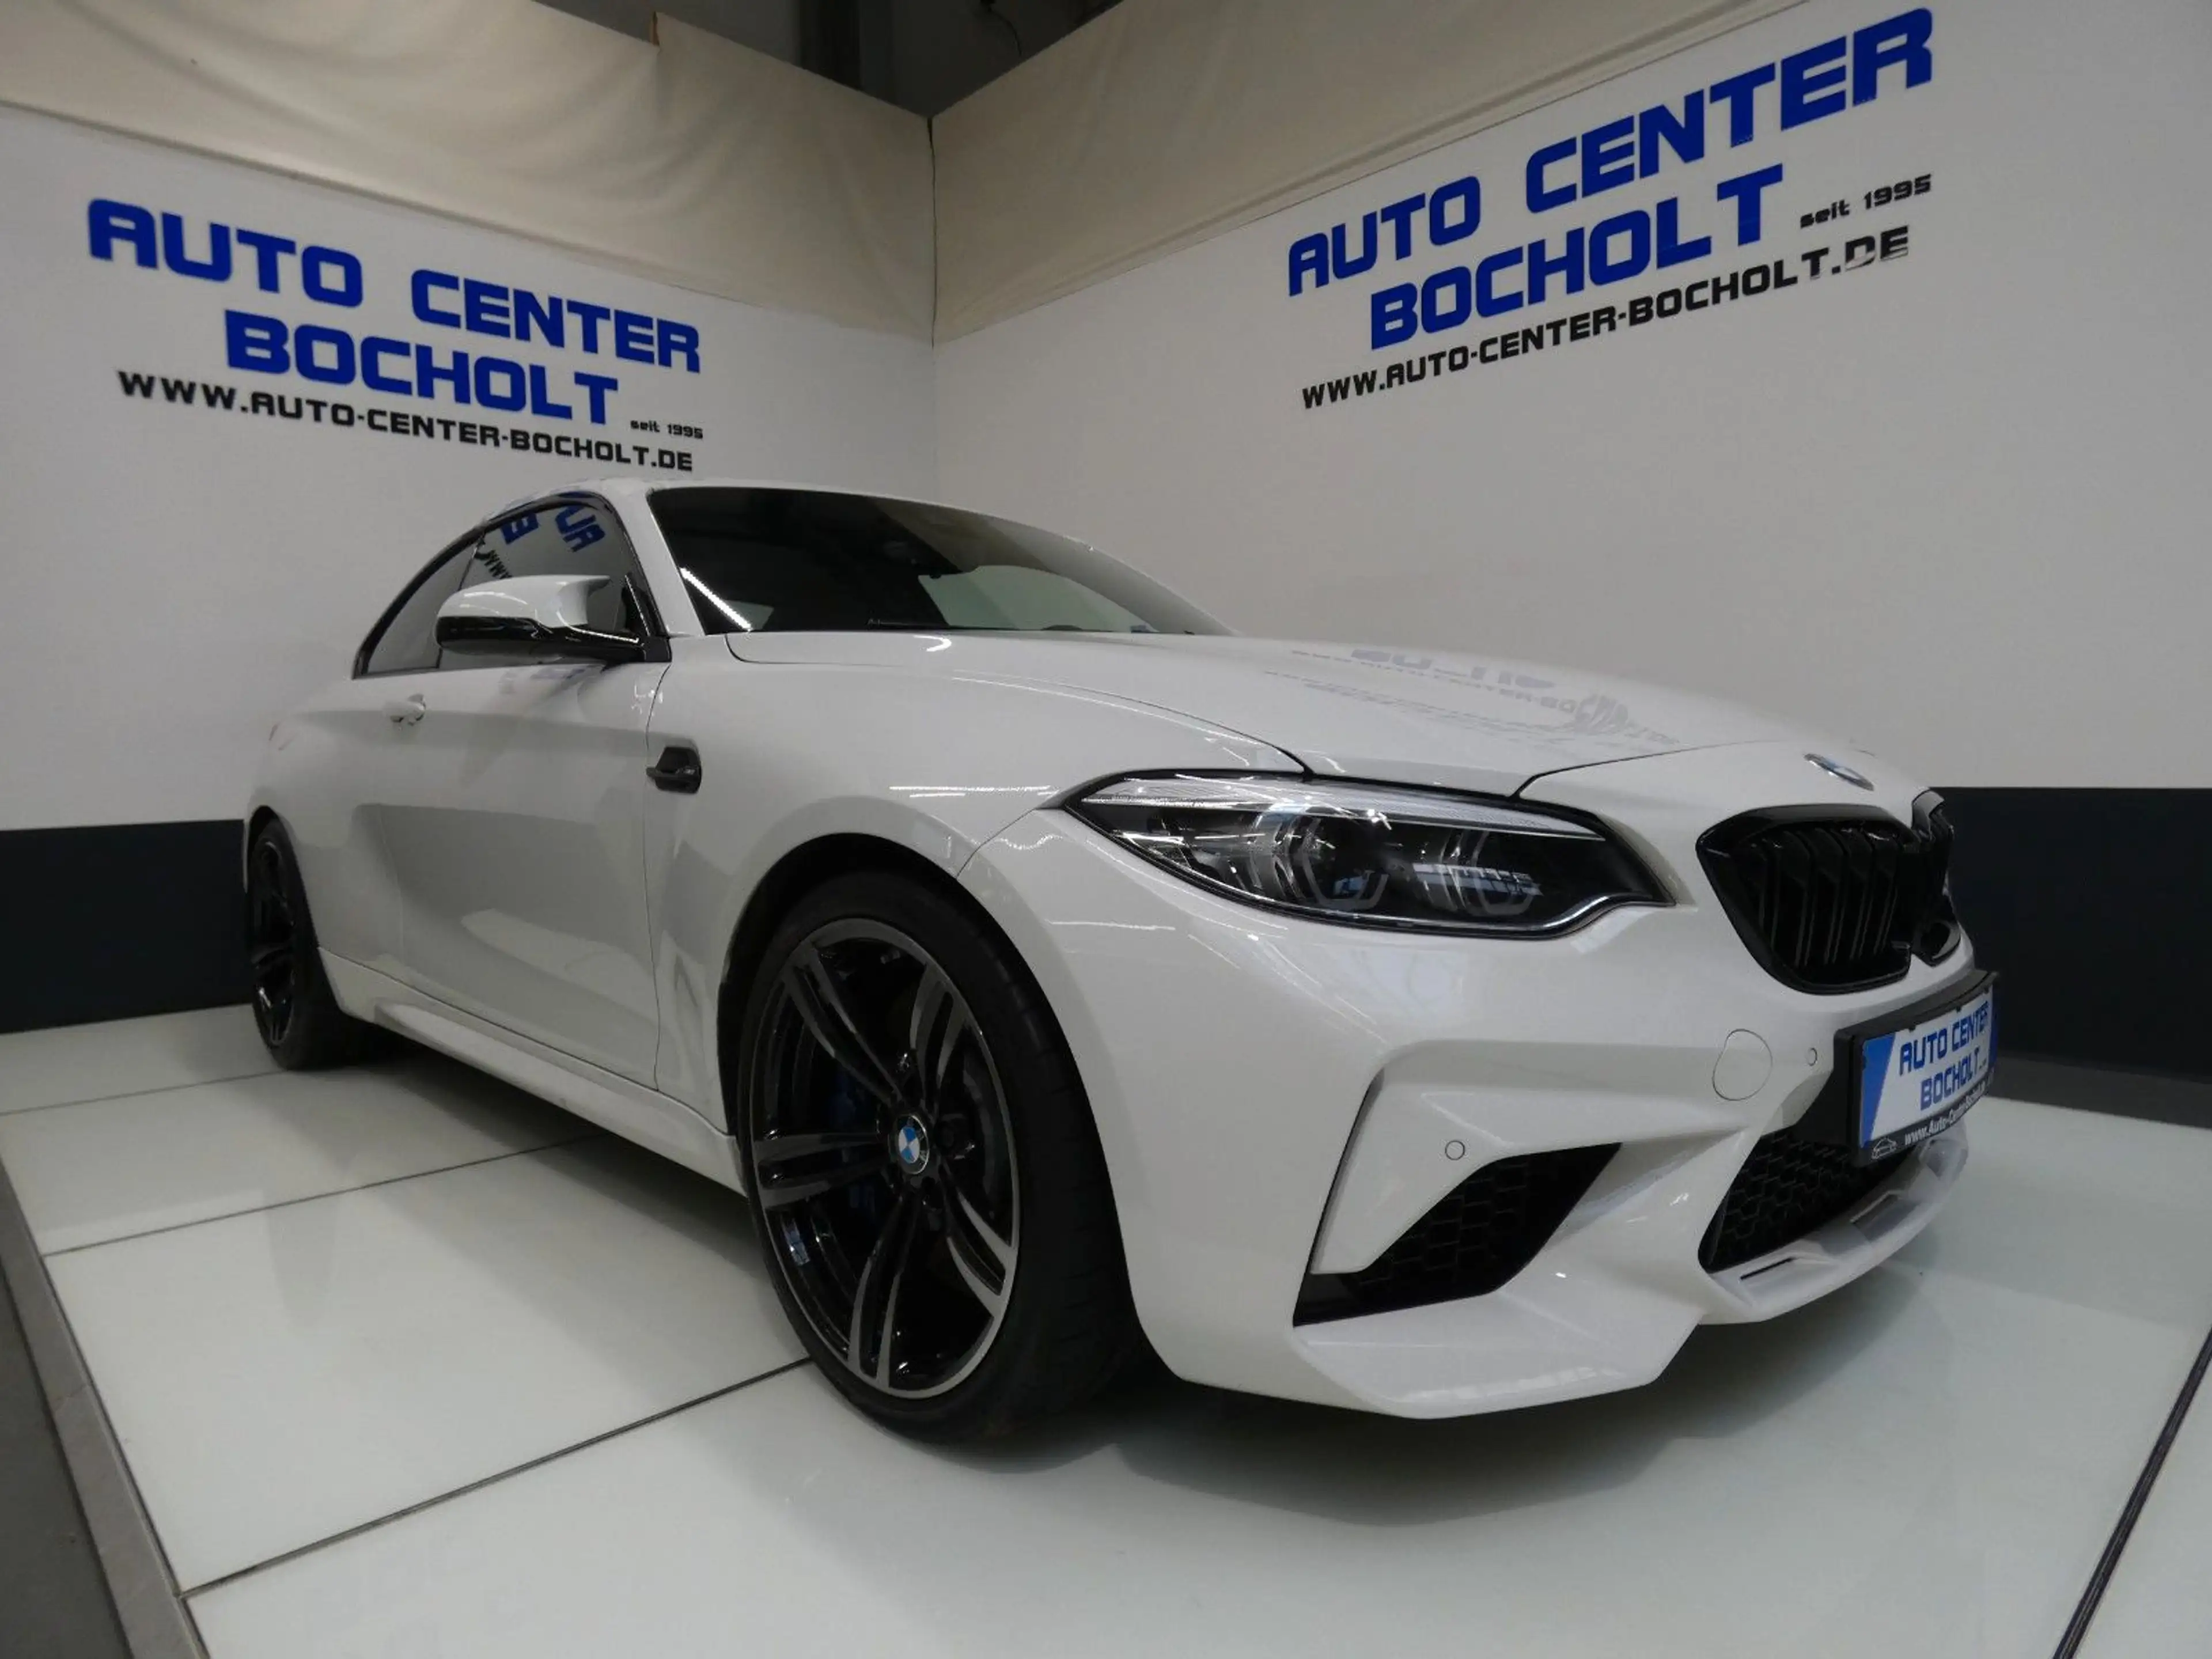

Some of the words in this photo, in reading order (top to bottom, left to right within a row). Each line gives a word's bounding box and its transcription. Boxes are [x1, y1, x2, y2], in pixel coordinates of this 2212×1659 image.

[1289, 176, 1481, 296] AUTO
[1526, 8, 1934, 213] CENTER
[1800, 199, 1850, 228] seit
[1863, 173, 1932, 210] 1995
[88, 199, 365, 308] AUTO
[411, 269, 701, 373] CENTER
[1371, 164, 1785, 350] BOCHOLT
[224, 310, 620, 426] BOCHOLT
[668, 423, 703, 440] 1995
[1899, 1028, 1948, 1076] AUTO
[1920, 1047, 1980, 1111] BOCHOLT
